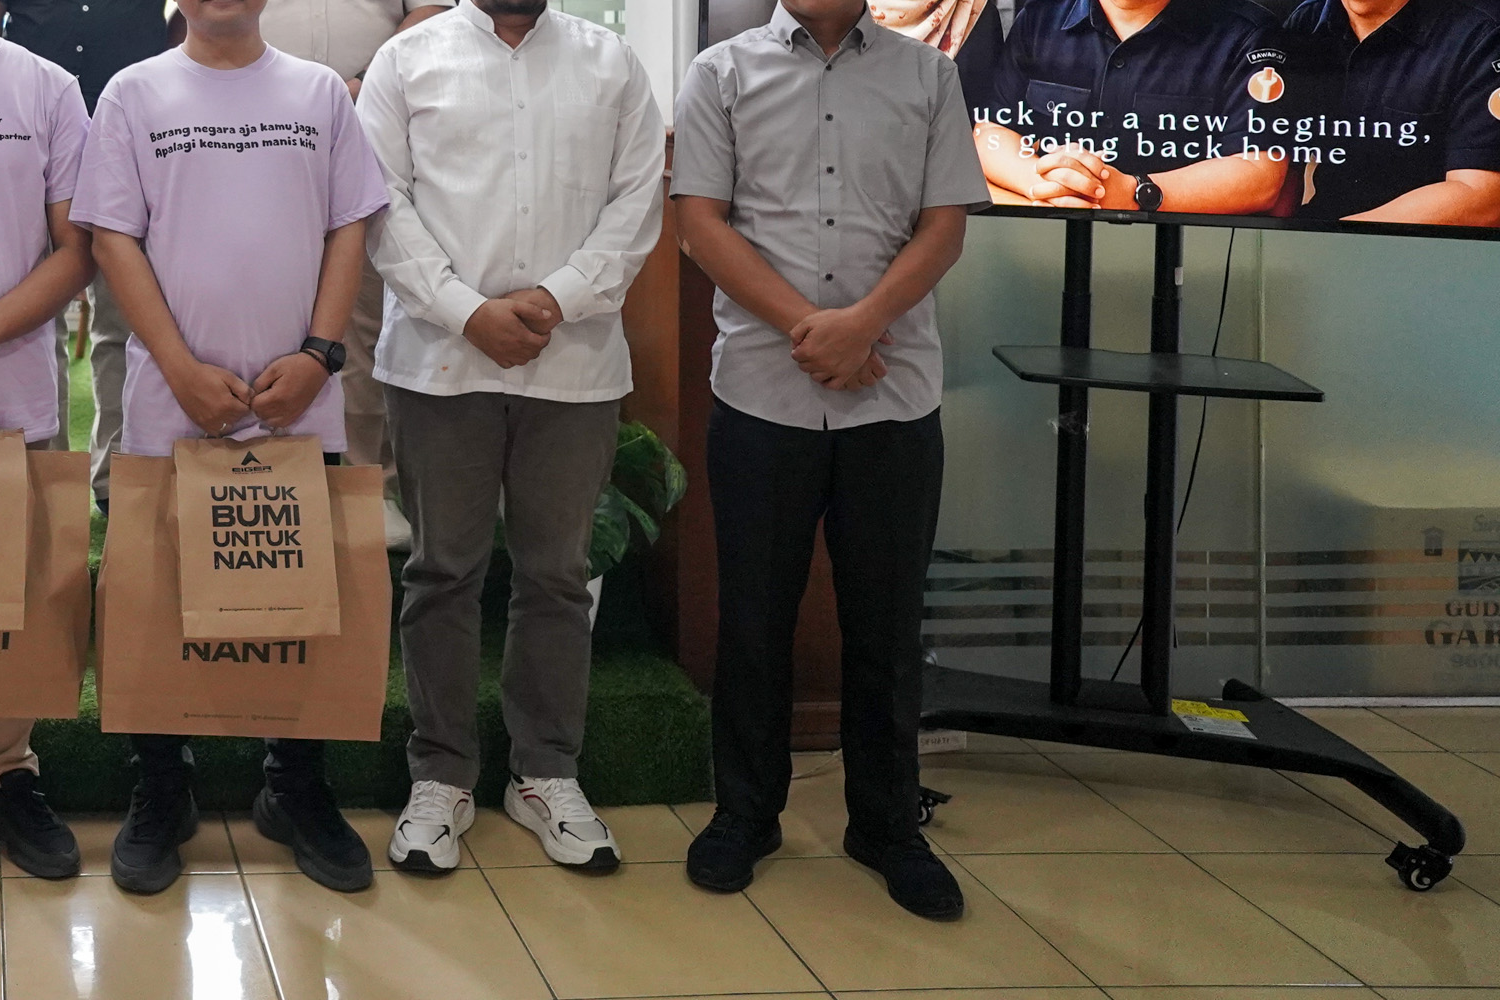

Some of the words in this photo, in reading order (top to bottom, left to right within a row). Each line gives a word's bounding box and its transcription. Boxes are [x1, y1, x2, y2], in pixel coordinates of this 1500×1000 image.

[150, 125, 190, 143] Barang
[193, 125, 236, 137] negara
[239, 124, 257, 137] aja
[260, 122, 292, 132] kamu
[292, 122, 319, 137] jaga,
[973, 101, 1034, 125] uck
[1052, 102, 1104, 128] for
[1122, 112, 1139, 130] a
[1158, 113, 1228, 132] new
[1247, 109, 1431, 147] begining,
[0, 132, 32, 142] partner
[155, 139, 196, 159] Apalagi
[199, 139, 259, 153] kenangan
[262, 136, 297, 147] manis
[299, 137, 316, 151] kita
[1019, 132, 1119, 163] going
[1137, 132, 1223, 159] back
[1242, 136, 1346, 164] home
[232, 465, 272, 473] EIGER
[210, 486, 298, 501] UNTUK
[212, 504, 300, 527] BUMI
[213, 530, 301, 547] UNTUK
[214, 549, 303, 569] NANTI
[182, 640, 306, 664] NANTI
